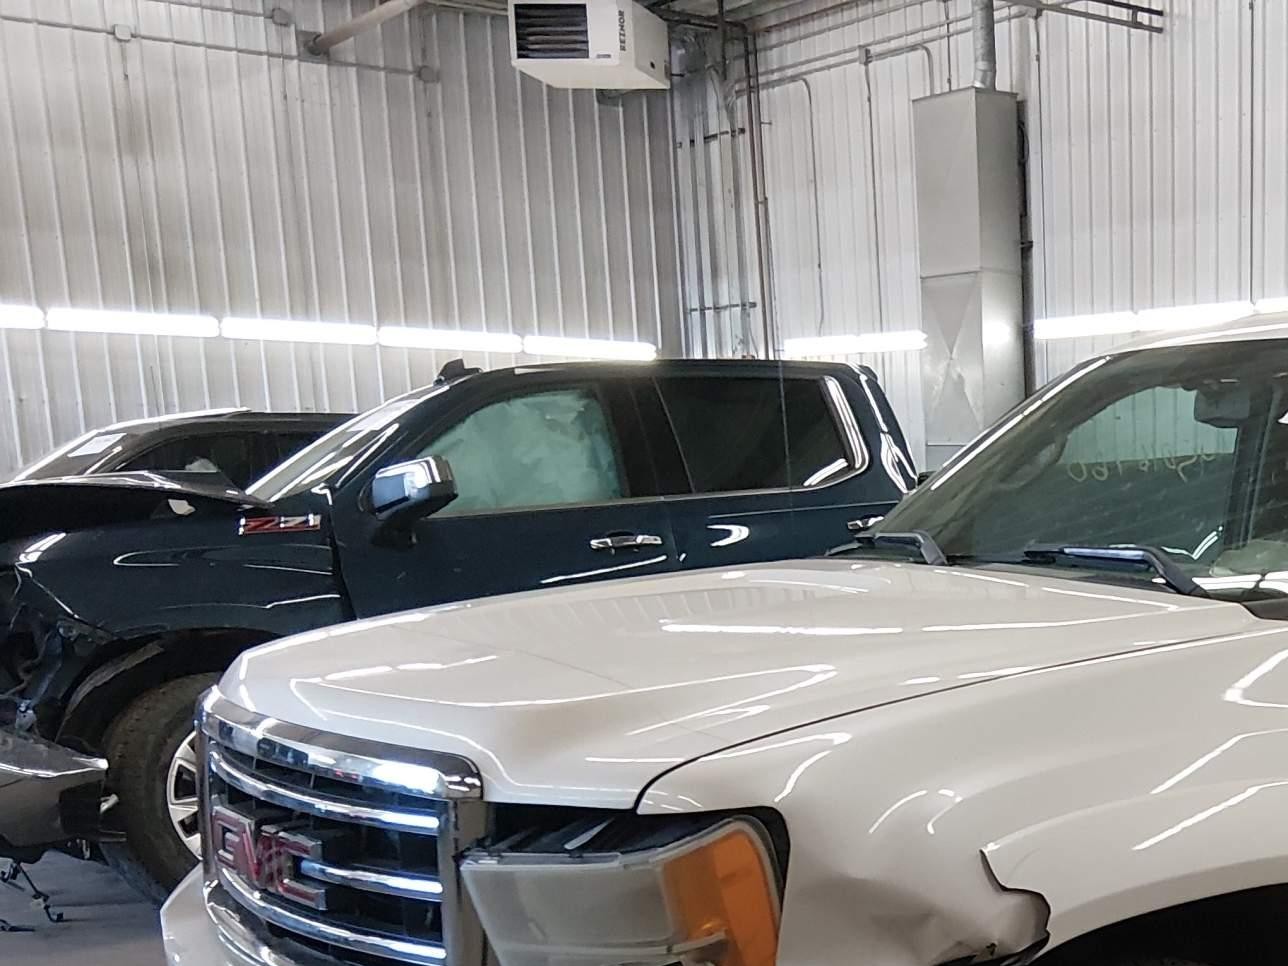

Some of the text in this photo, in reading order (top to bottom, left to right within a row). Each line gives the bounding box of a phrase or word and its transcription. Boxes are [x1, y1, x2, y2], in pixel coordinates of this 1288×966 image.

[618, 10, 626, 51] REZNOR
[239, 514, 321, 535] Z71
[211, 806, 327, 910] GMC
